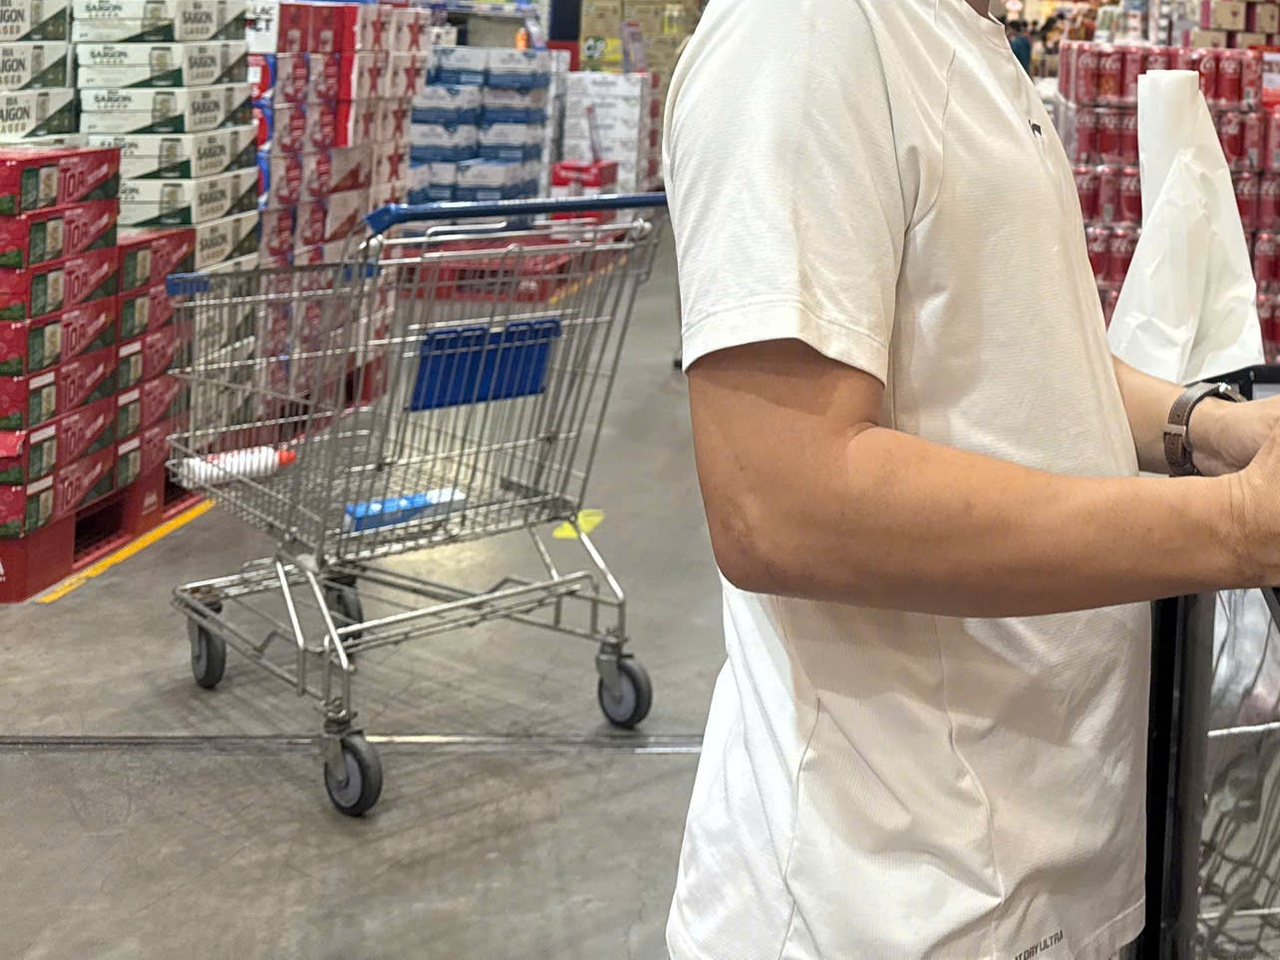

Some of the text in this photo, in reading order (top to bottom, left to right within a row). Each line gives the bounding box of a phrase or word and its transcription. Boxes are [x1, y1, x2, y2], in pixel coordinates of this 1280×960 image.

[0, 107, 30, 122] AIGON
[1024, 943, 1039, 960] DRY
[1039, 930, 1064, 952] ULTRA
